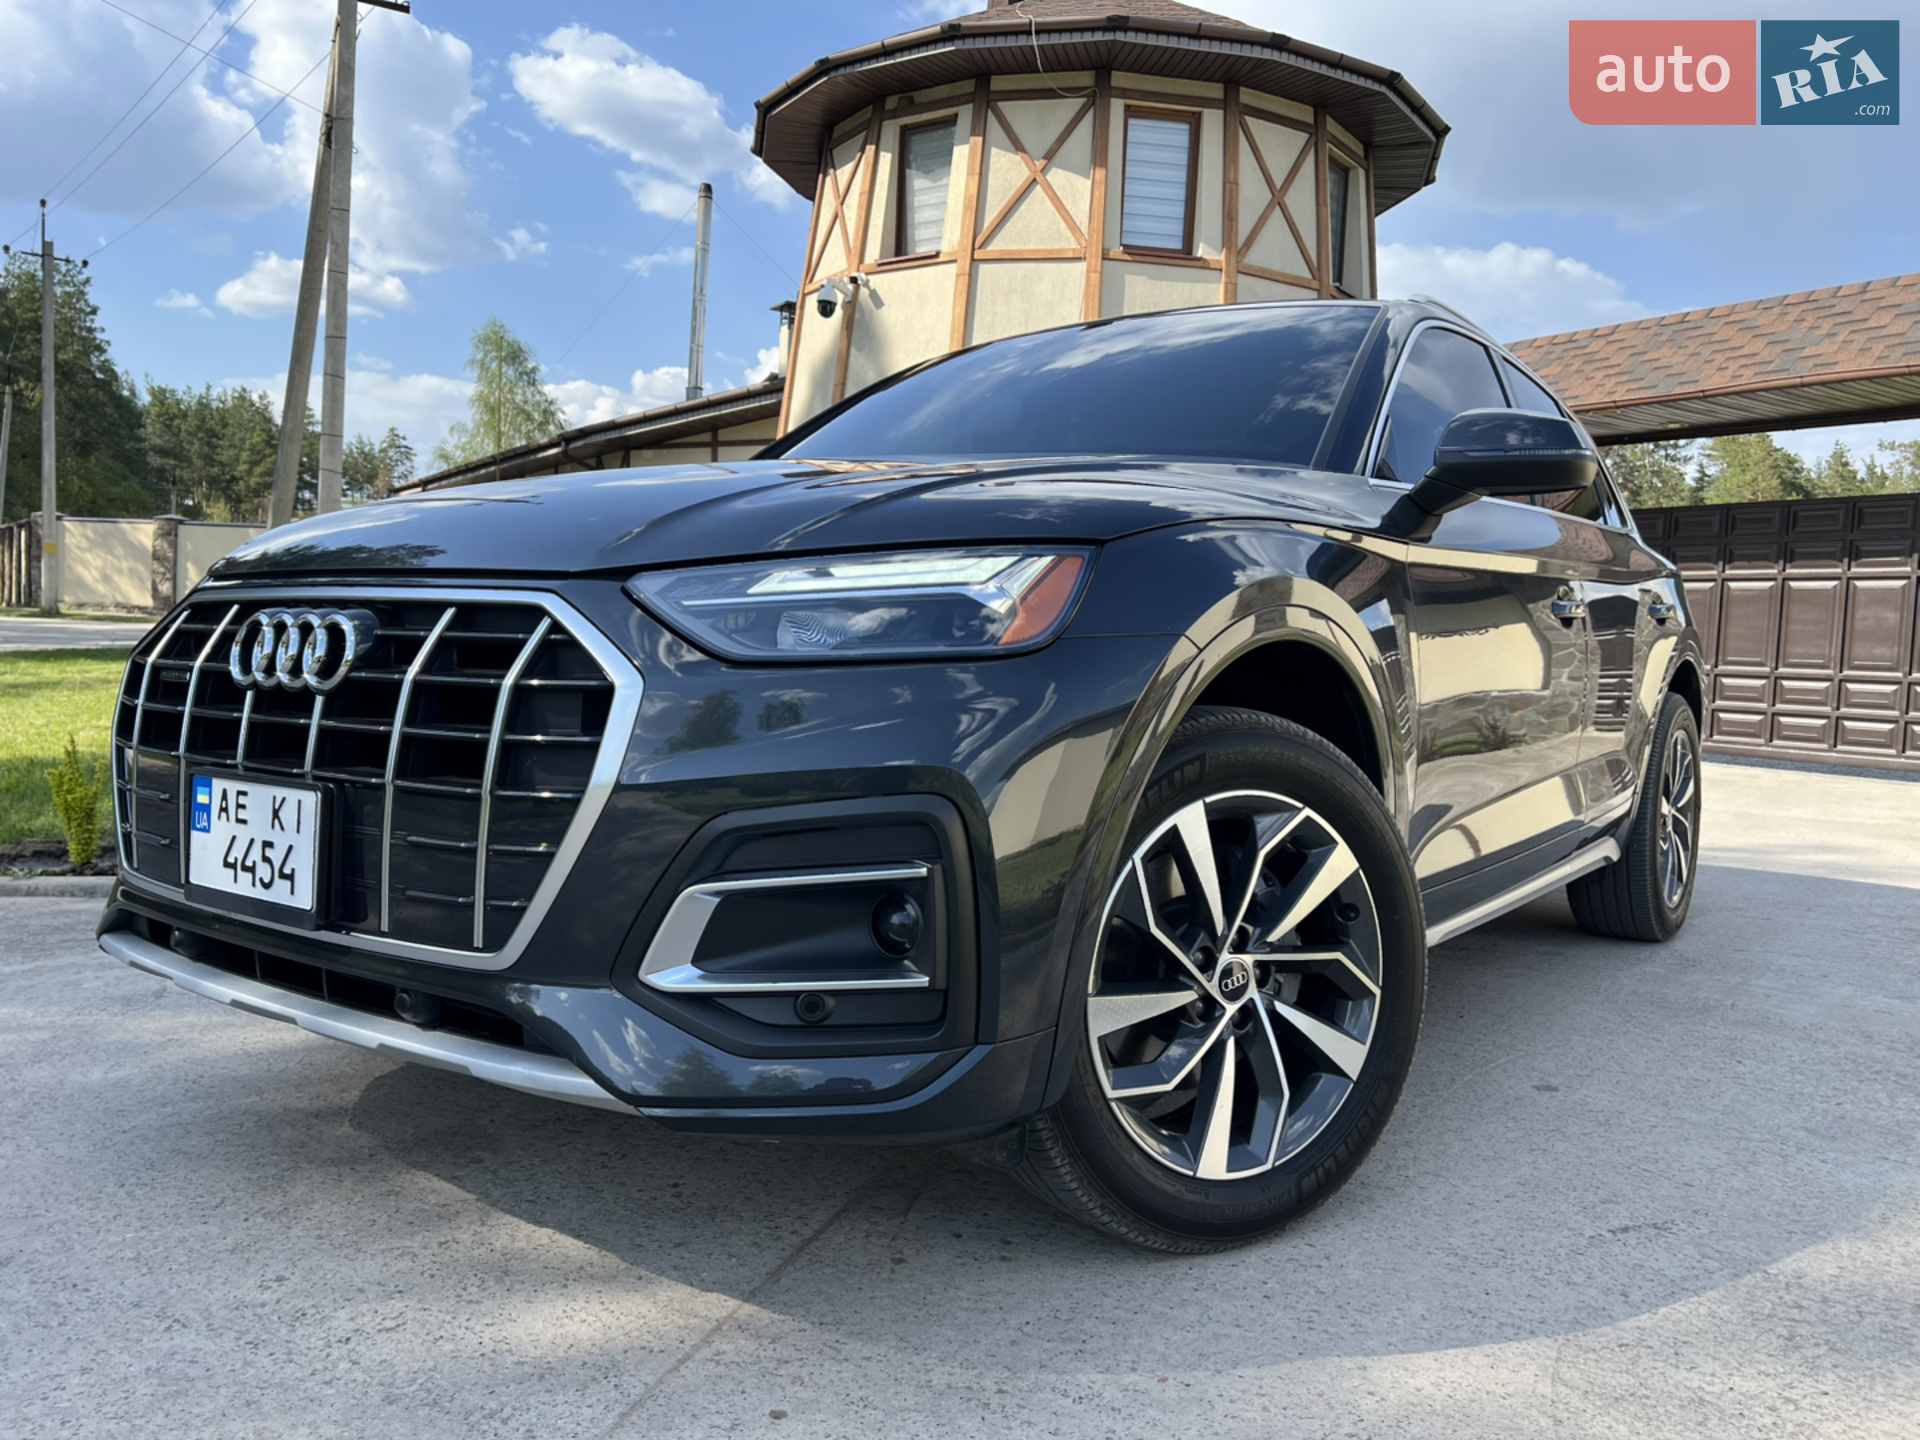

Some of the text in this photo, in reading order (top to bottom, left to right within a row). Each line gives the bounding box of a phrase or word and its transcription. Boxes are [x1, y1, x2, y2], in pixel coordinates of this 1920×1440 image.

[195, 811, 209, 829] UA
[217, 787, 302, 834] AE KI
[222, 834, 296, 896] 4454
[1300, 1079, 1392, 1199] MICHELIN
[1222, 1190, 1289, 1221] PREMIER
